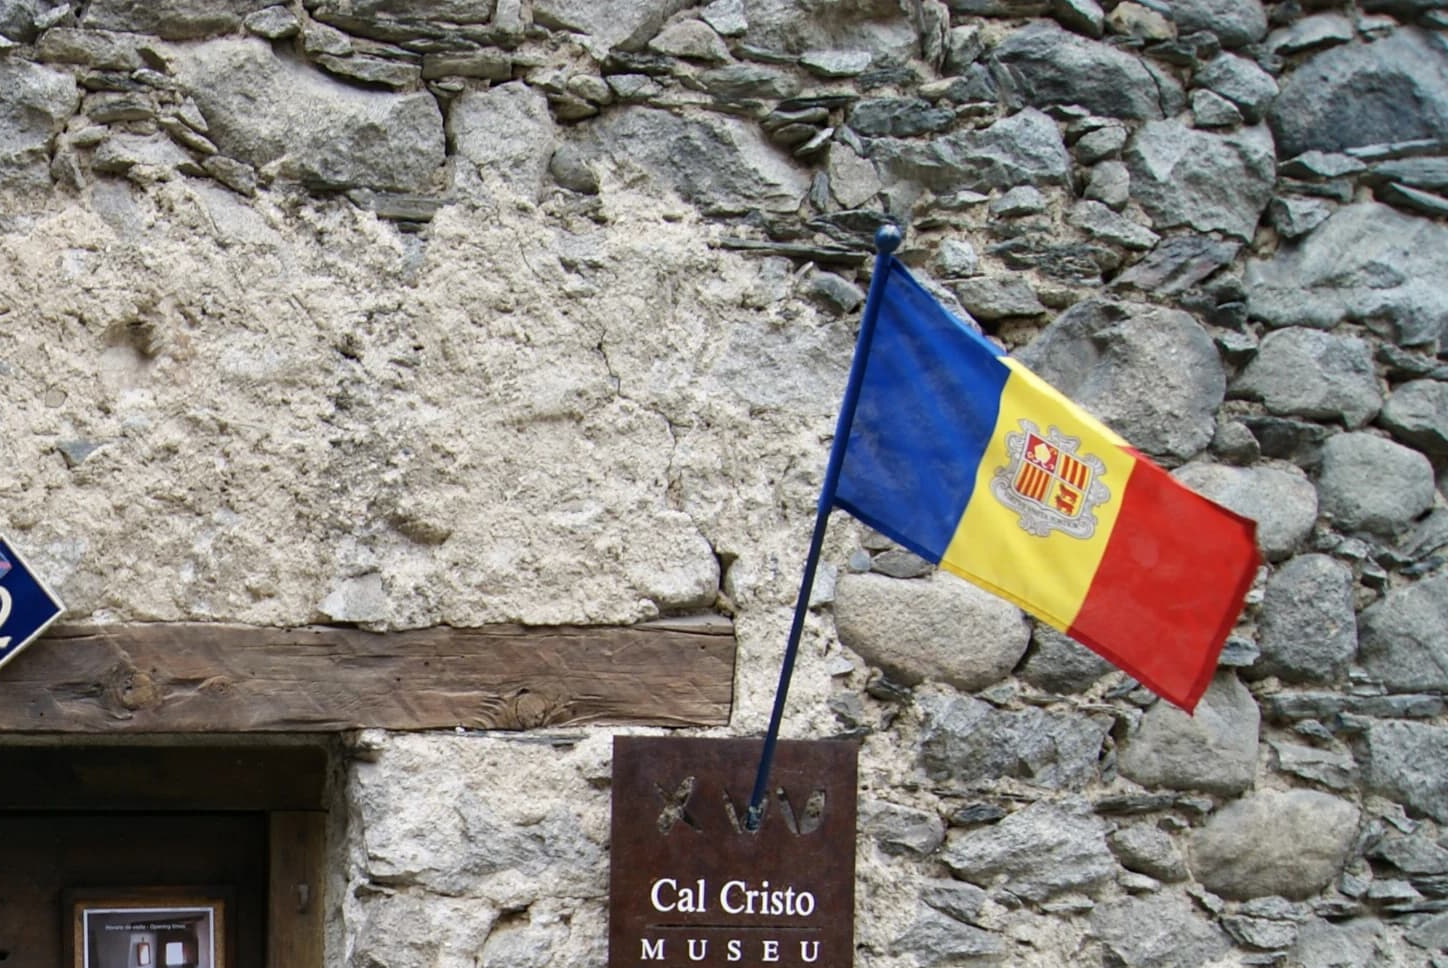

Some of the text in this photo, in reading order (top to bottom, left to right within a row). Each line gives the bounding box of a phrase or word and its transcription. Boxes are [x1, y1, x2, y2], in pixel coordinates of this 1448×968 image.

[650, 878, 816, 916] Cal Cristo
[641, 939, 820, 962] MUSEU
